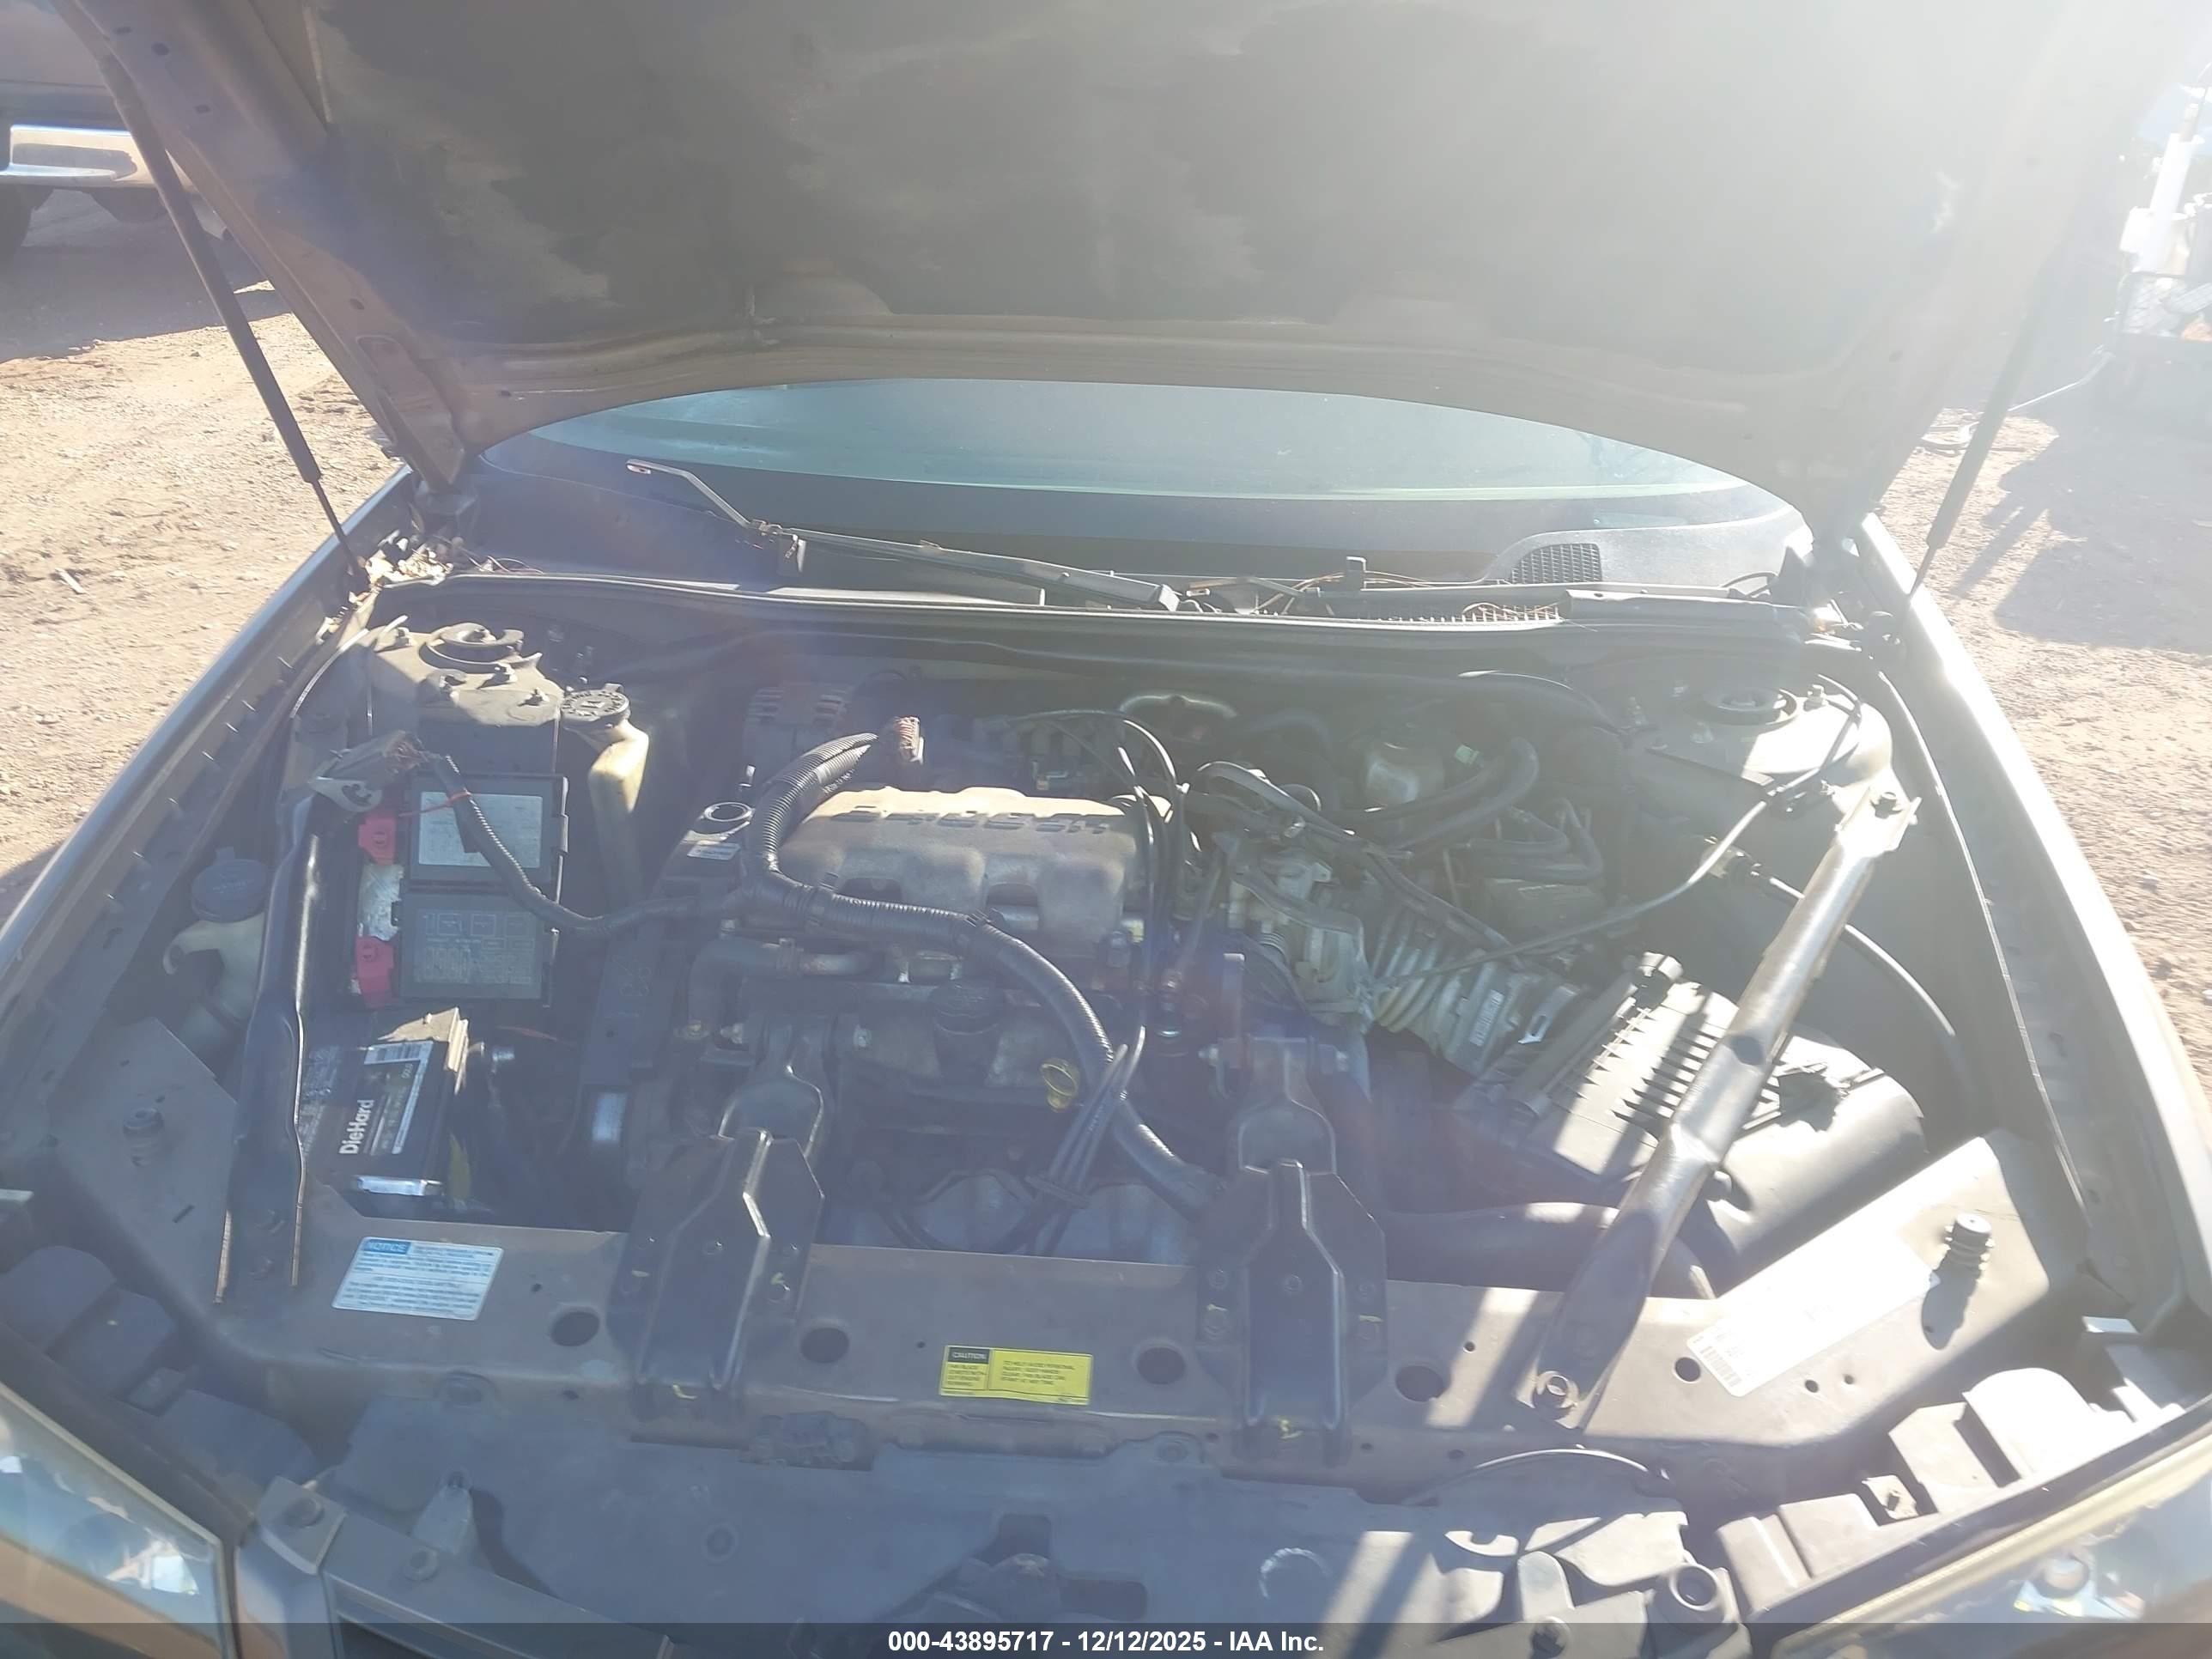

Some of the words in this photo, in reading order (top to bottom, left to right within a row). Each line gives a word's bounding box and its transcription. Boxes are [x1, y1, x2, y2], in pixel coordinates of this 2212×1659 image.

[338, 1099, 375, 1154] DieHard
[368, 1242, 406, 1253] NOTICE
[951, 1352, 988, 1360] CAUTION
